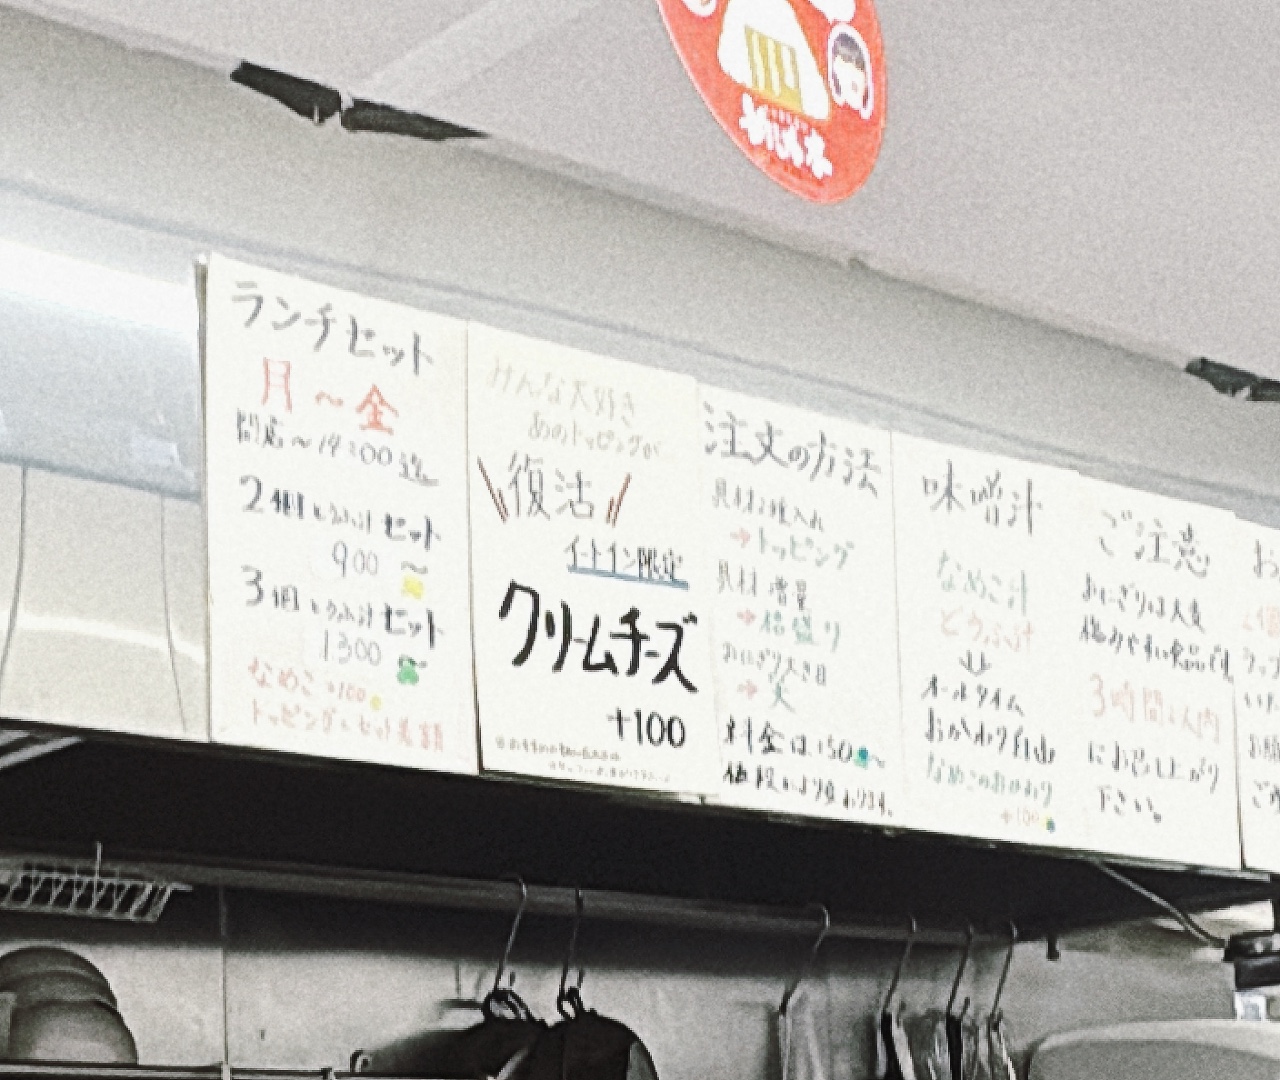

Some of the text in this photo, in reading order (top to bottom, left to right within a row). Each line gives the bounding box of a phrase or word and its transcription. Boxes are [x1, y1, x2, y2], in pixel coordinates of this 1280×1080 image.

[232, 281, 435, 376] ランチセット
[702, 401, 882, 498] 注文の方法
[922, 459, 1043, 537] 味噌汁
[1099, 509, 1210, 578] ご注意
[498, 579, 699, 694] クリームチーズ
[606, 707, 686, 748] +100
